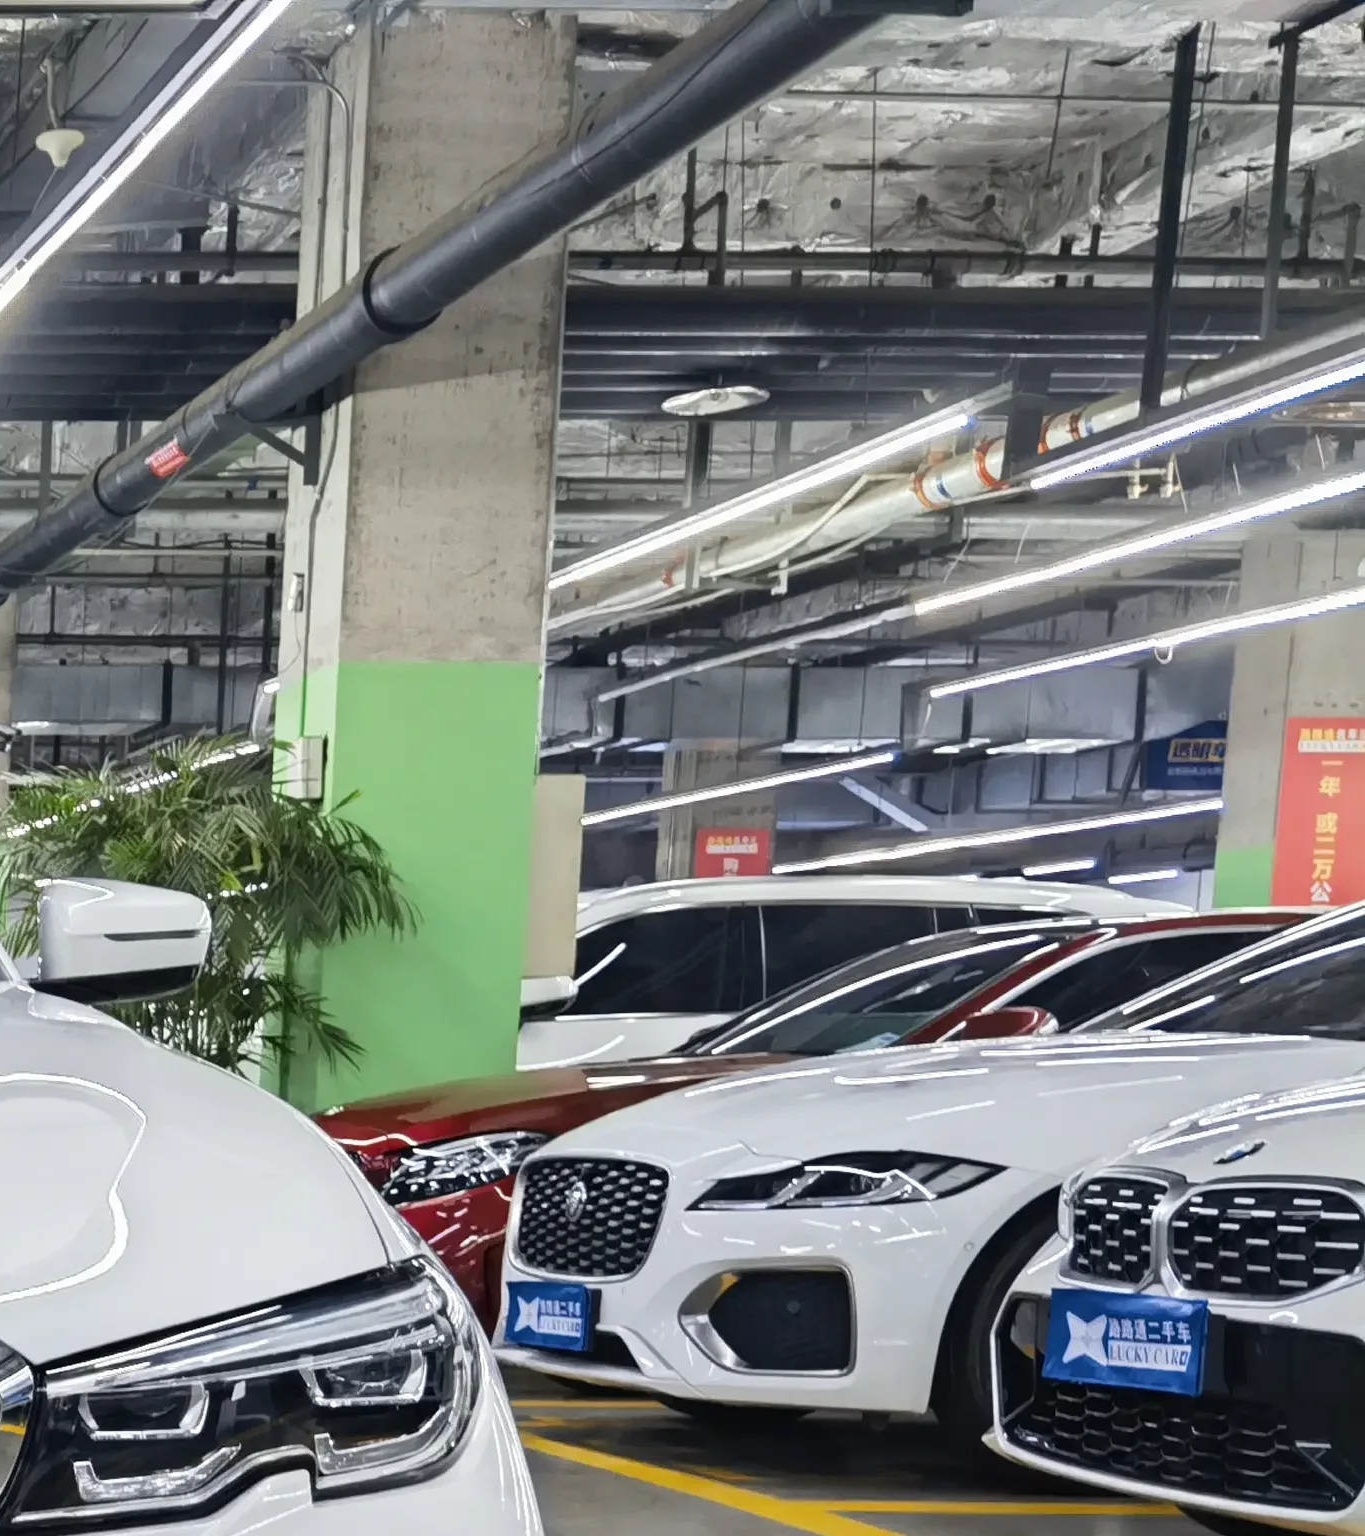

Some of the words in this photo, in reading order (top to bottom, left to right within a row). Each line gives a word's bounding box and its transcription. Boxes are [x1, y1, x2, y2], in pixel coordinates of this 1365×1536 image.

[1107, 1316, 1192, 1344] 路路通二手车
[1109, 1343, 1149, 1363] LUCKY
[1153, 1347, 1179, 1366] CAR
